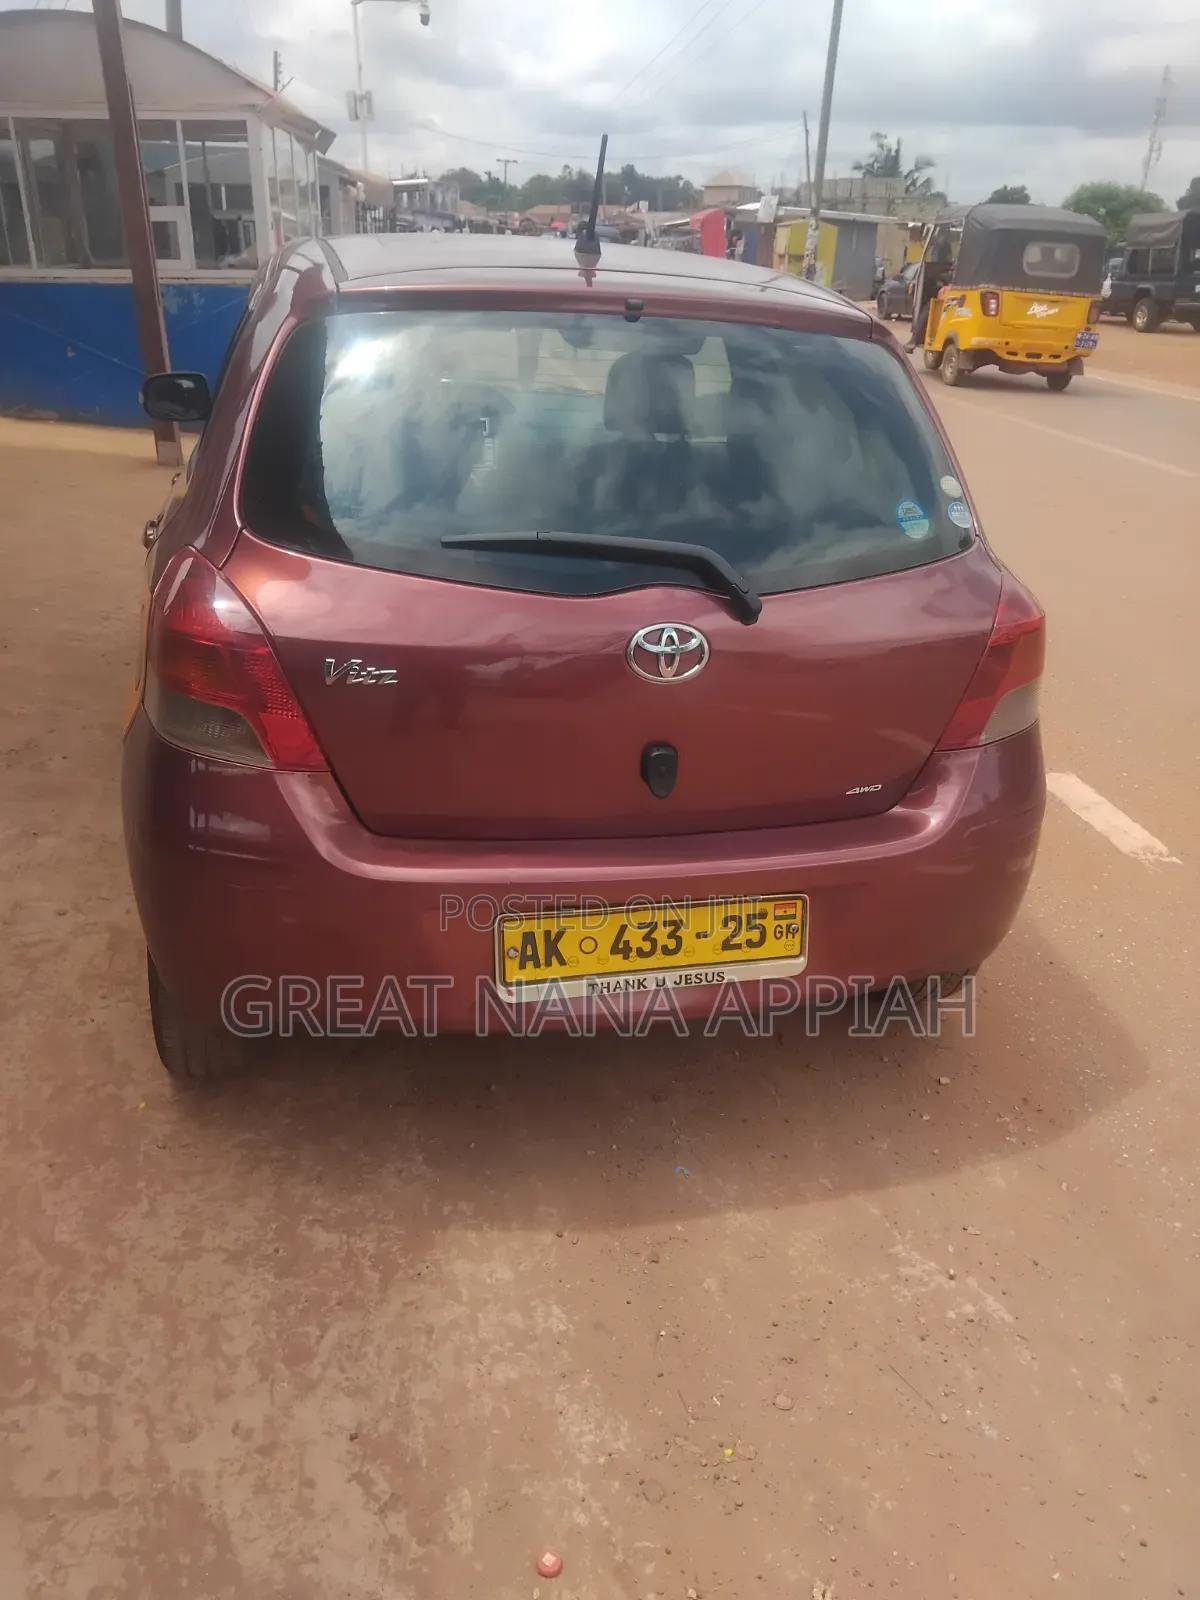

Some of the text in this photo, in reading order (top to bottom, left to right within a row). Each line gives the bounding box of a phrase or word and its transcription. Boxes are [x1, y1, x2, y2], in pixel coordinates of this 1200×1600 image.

[324, 658, 398, 686] Vitz
[845, 784, 882, 795] 4WD
[518, 928, 567, 970] AK
[609, 919, 684, 961] 433
[720, 908, 768, 951] 25
[588, 971, 725, 995] THANK U JESUS
